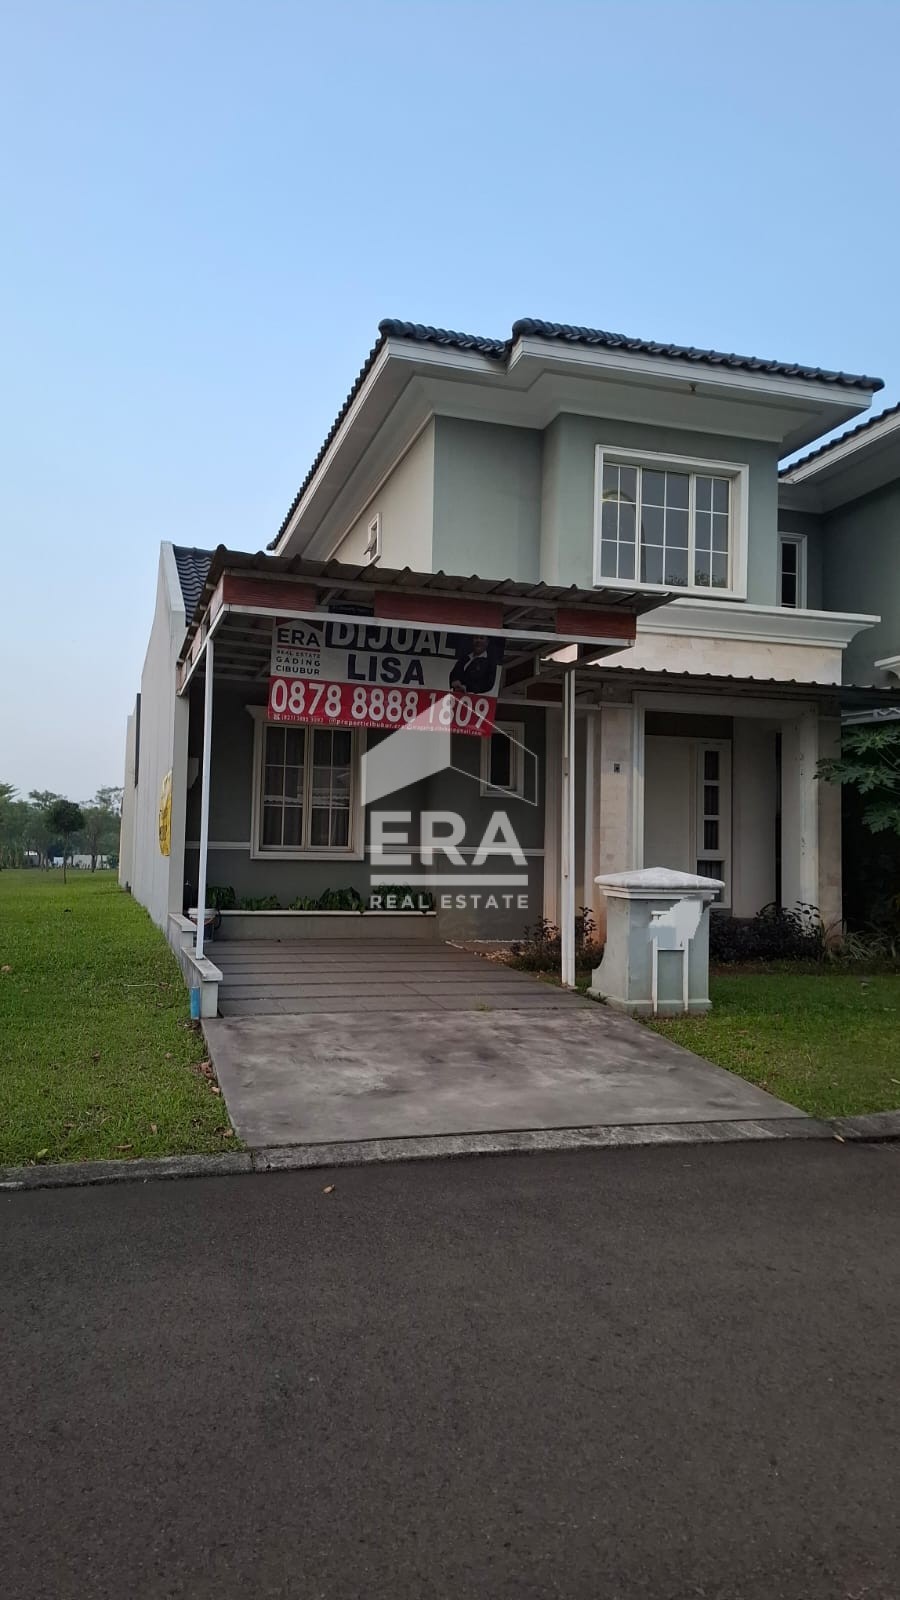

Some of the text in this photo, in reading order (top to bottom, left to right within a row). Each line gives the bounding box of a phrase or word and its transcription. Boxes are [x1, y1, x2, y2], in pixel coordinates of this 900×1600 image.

[277, 628, 321, 648] ERA
[331, 622, 457, 657] DIJUAL
[275, 656, 321, 668] GADING
[275, 665, 321, 679] CIBUBUR
[347, 653, 425, 686] LISA
[271, 678, 490, 730] 0878 8888 1809
